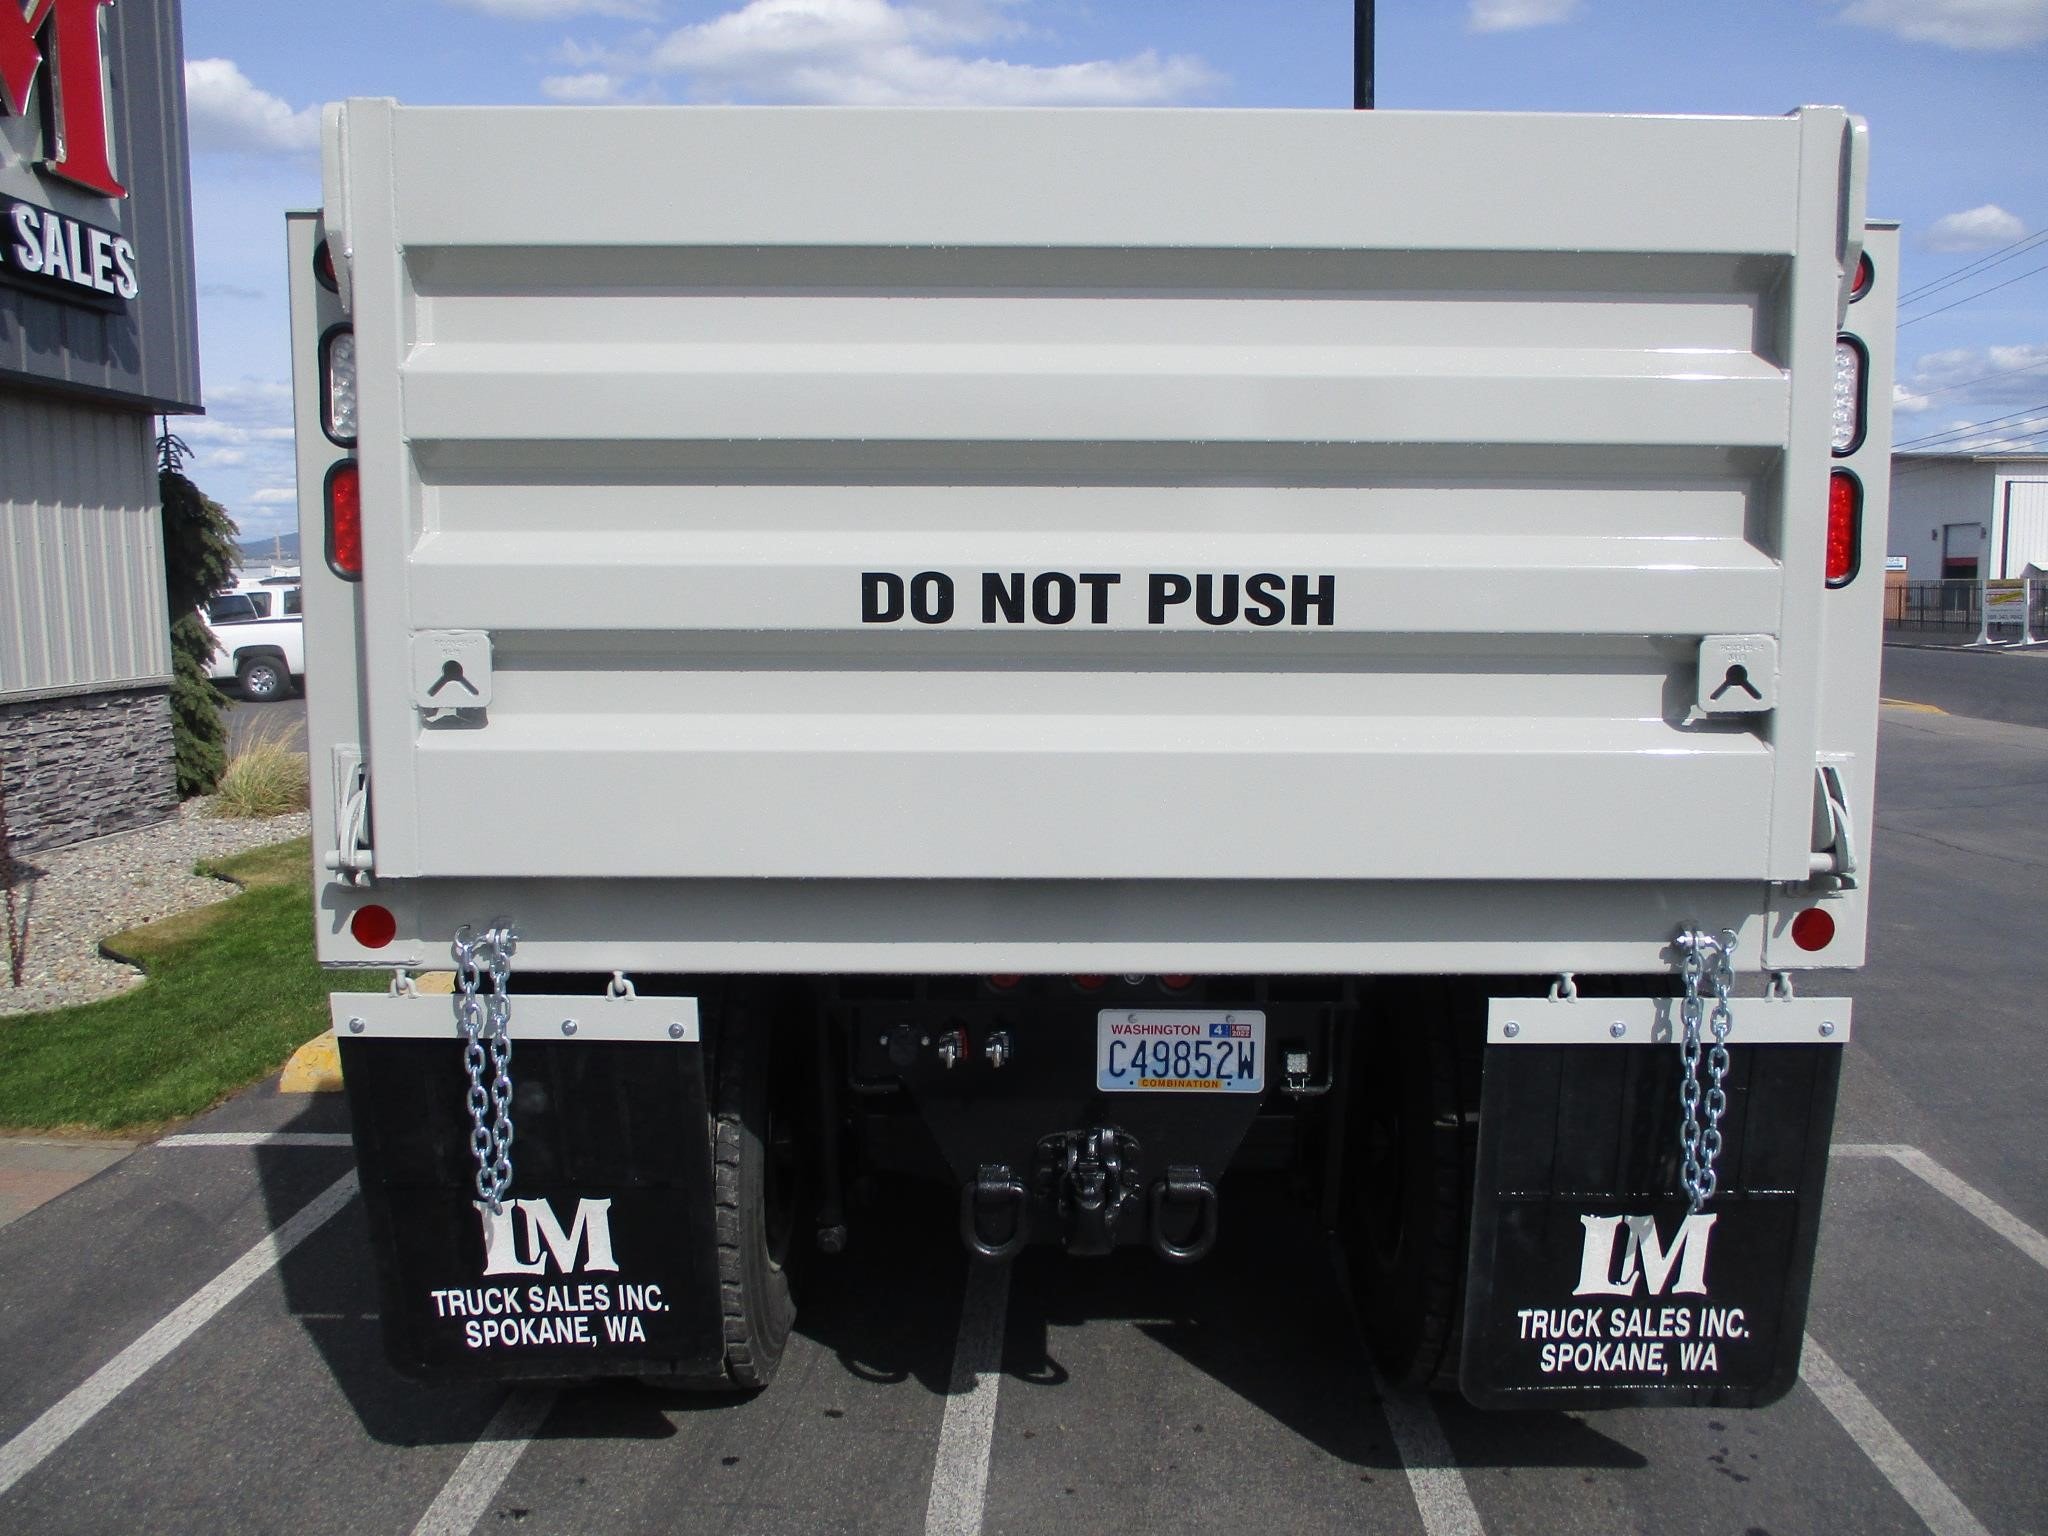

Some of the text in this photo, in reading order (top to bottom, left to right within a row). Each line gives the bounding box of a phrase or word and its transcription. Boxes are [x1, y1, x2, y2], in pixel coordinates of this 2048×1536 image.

[11, 203, 139, 299] SALES
[861, 571, 1335, 626] DO NOT PUSH
[1111, 1024, 1201, 1036] WASHINGTON
[1213, 1024, 1223, 1035] 4
[1109, 1040, 1255, 1080] C49852W
[1142, 1079, 1219, 1089] COMBINATION
[473, 1198, 619, 1276] LM
[1572, 1213, 1717, 1296] LM
[431, 1284, 670, 1317] TRUCK SALES INC.
[465, 1315, 646, 1348] SPOKANE, WA
[1517, 1307, 1750, 1339] TRUCK SALES INC.
[1540, 1342, 1718, 1376] SPOKANE, WA
